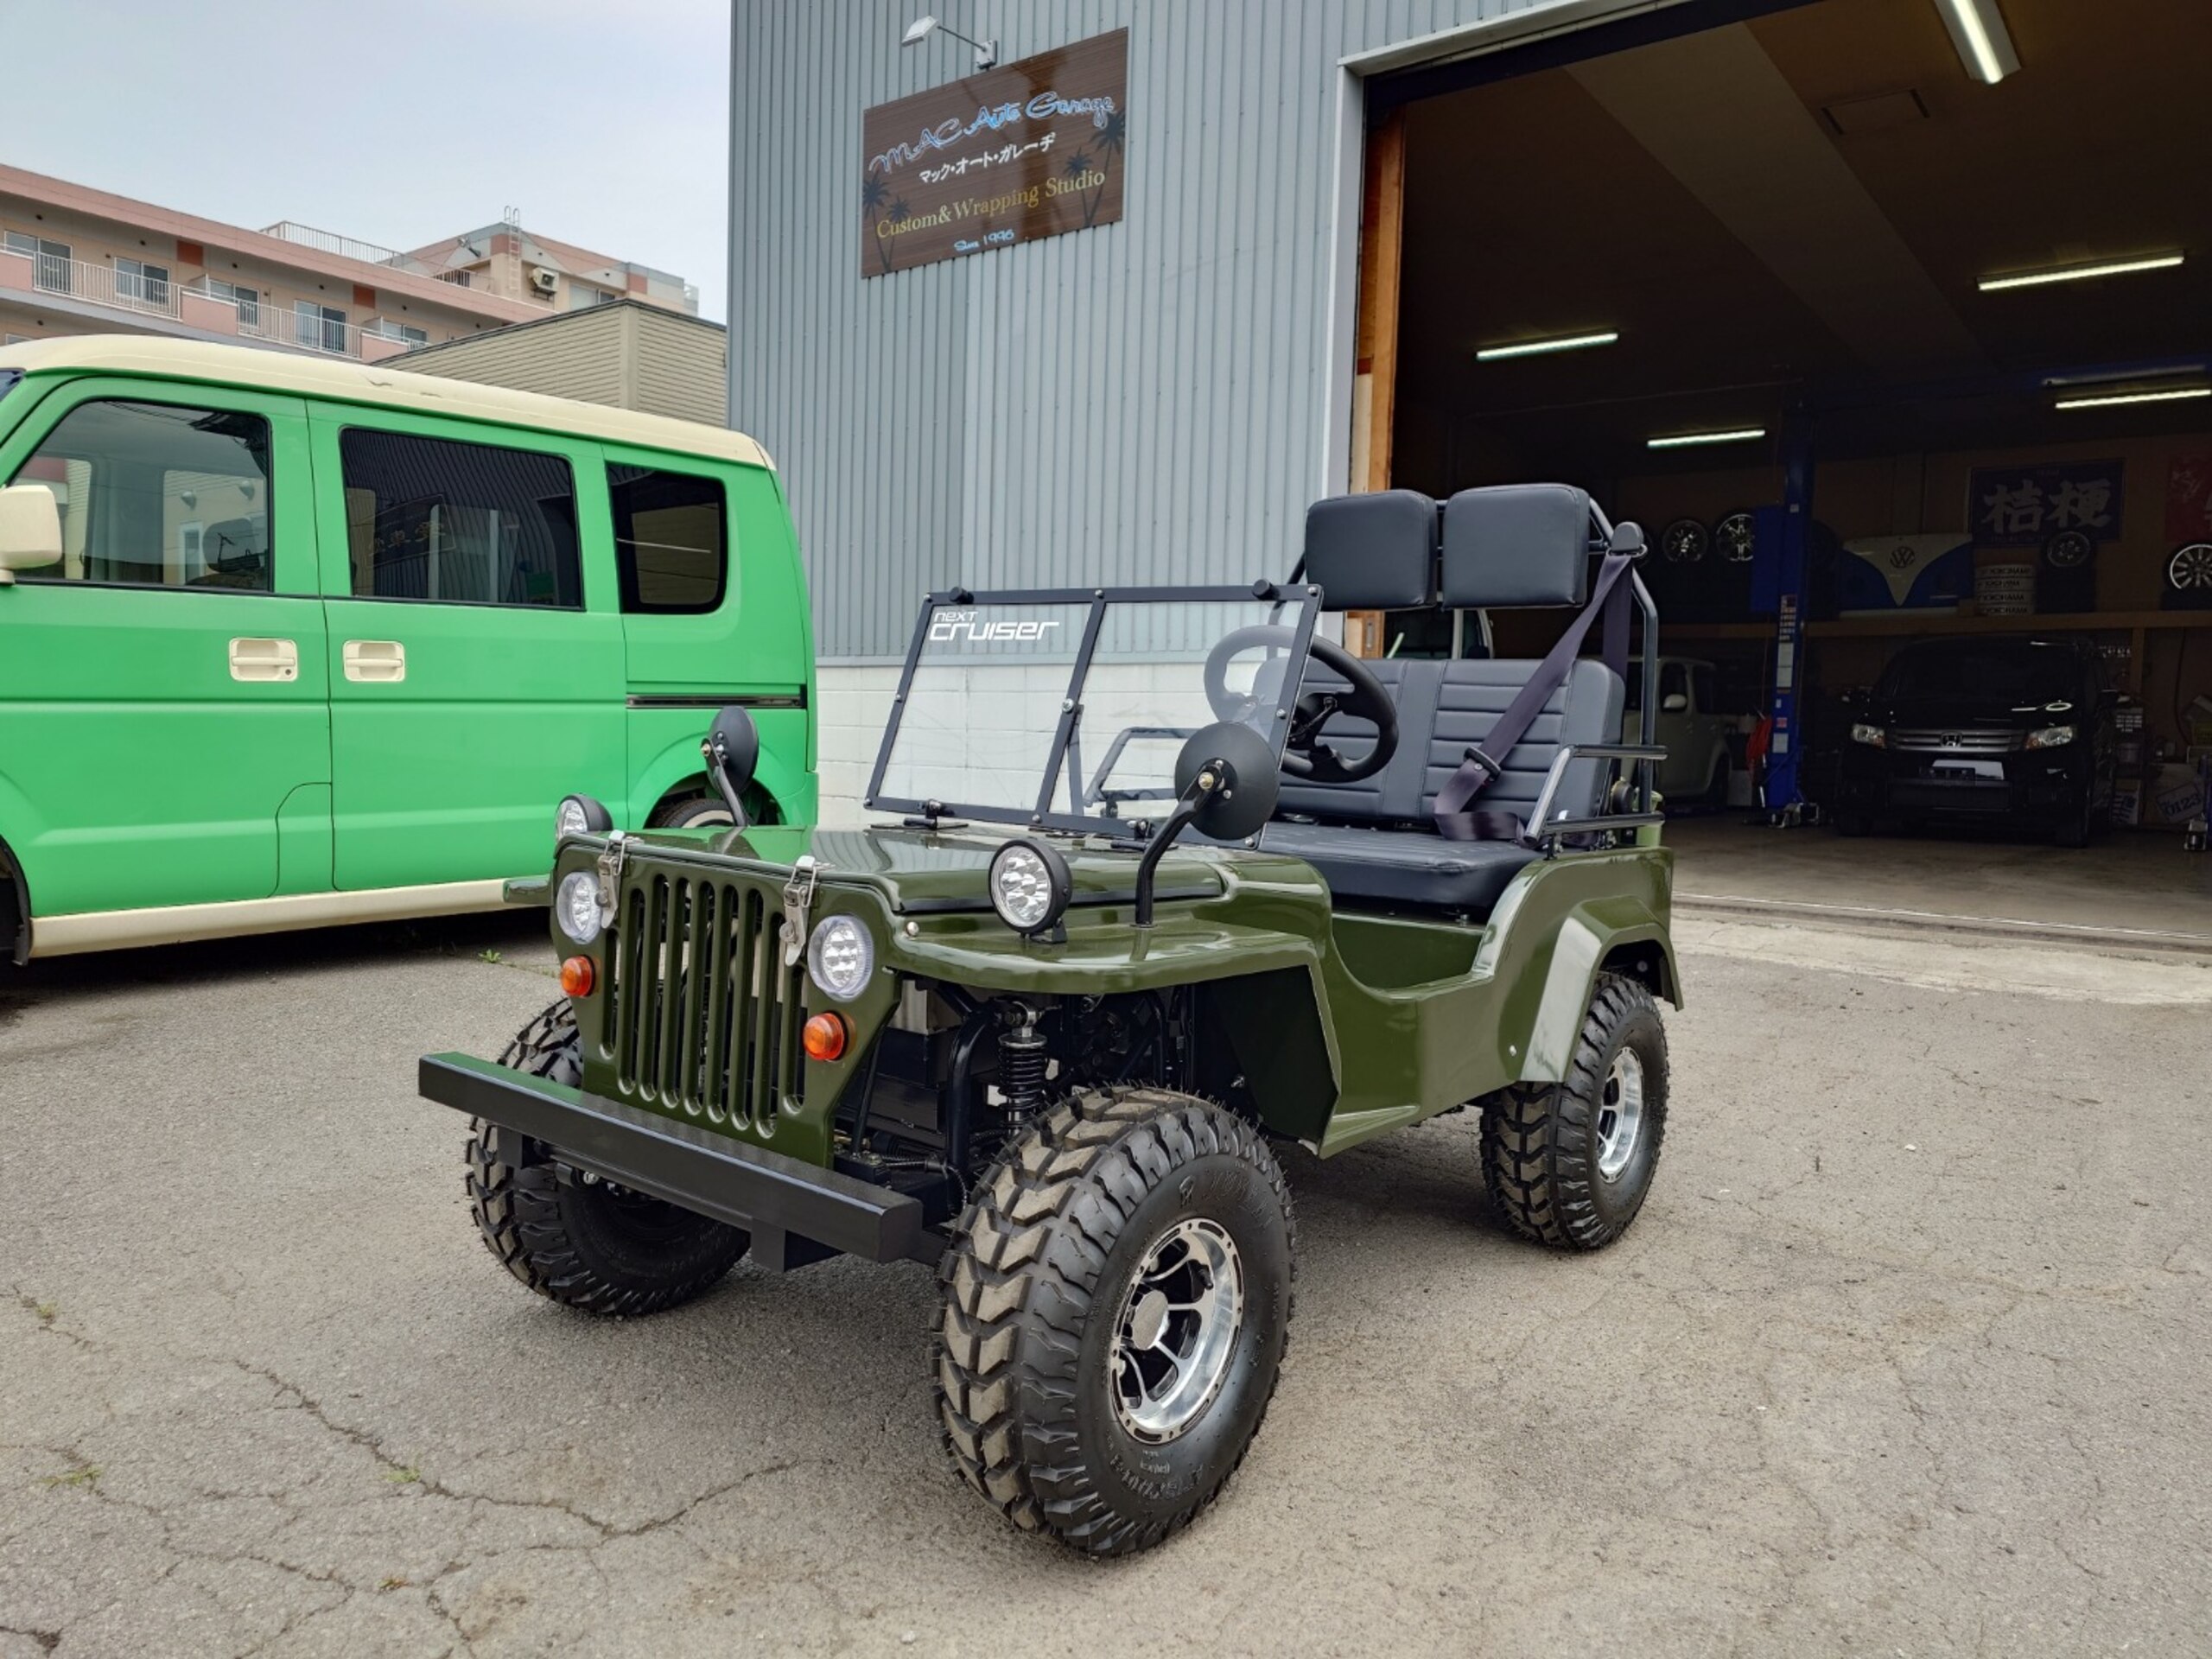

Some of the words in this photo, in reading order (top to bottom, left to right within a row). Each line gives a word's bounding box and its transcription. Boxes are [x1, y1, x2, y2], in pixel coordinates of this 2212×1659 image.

[963, 101, 1021, 135] Auto
[1025, 91, 1116, 129] Garage
[1045, 168, 1106, 198] Studio
